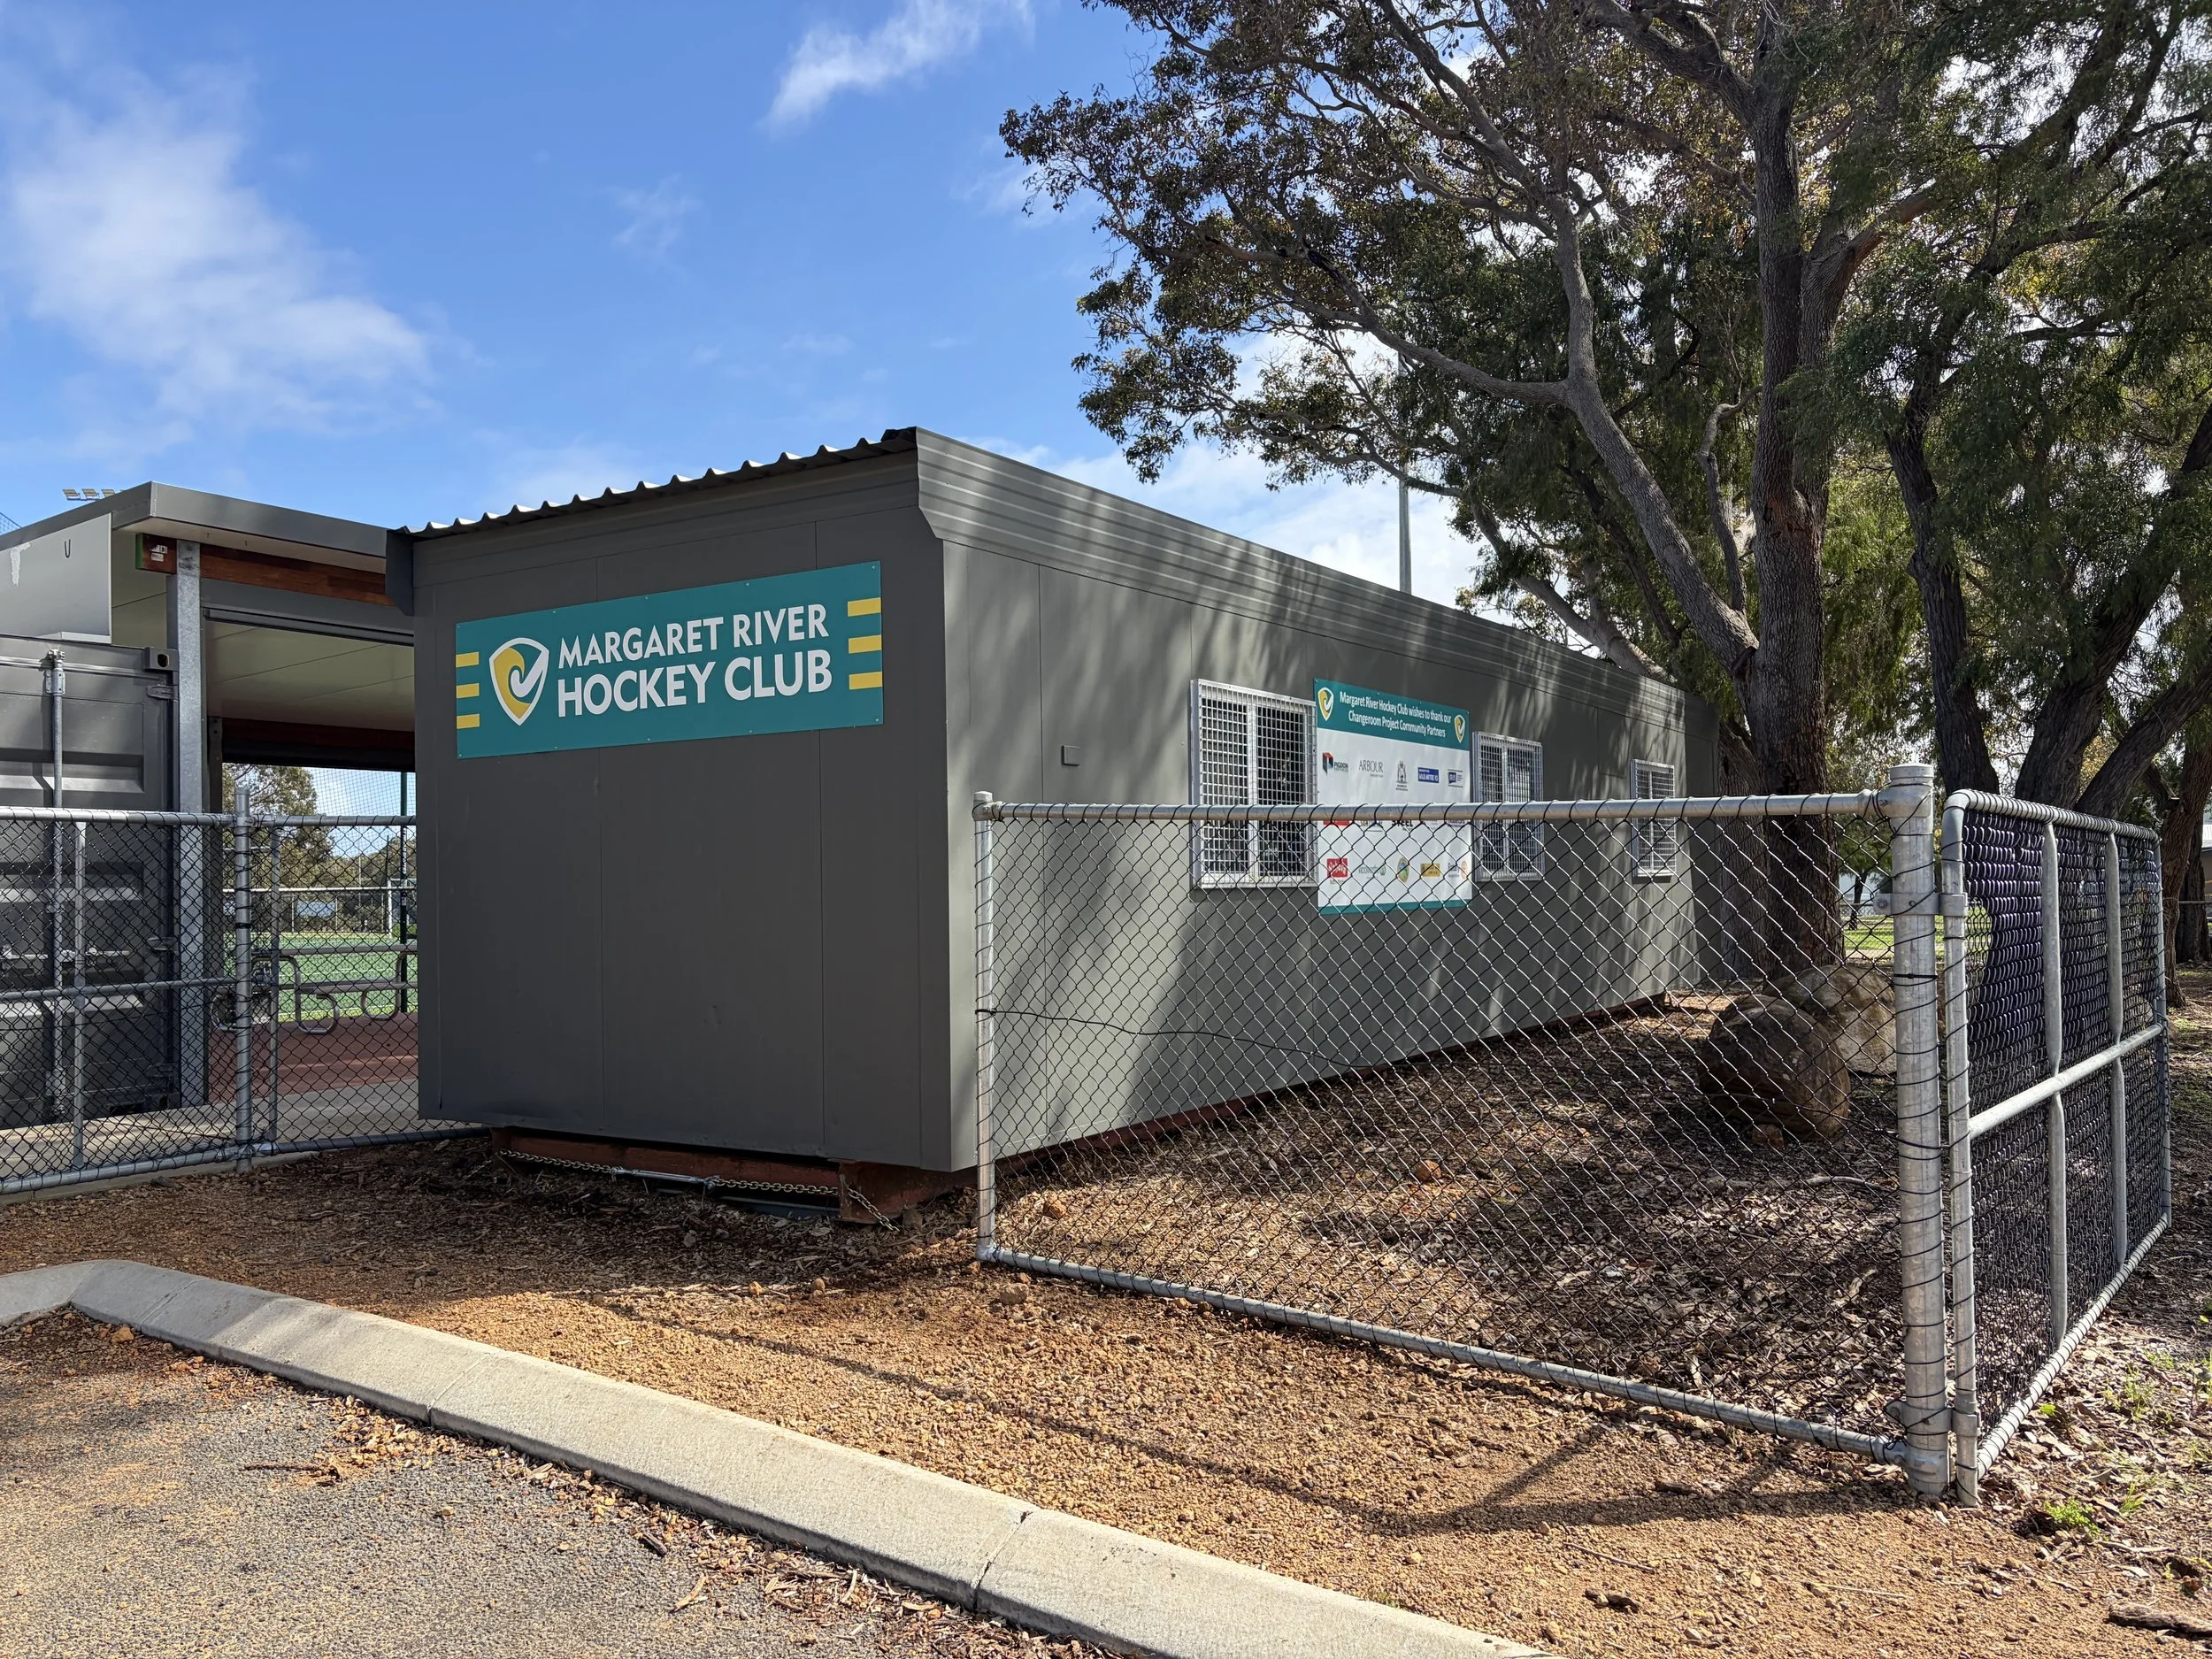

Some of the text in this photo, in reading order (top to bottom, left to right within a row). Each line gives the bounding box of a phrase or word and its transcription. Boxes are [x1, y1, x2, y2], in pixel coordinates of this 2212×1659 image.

[558, 603, 830, 670] MARGARET RIVER
[557, 649, 833, 718] HOCKEY CLUB
[1340, 691, 1365, 707] Margaret
[1365, 696, 1379, 710] River
[1379, 699, 1397, 715] Hockey
[1397, 703, 1408, 715] Club
[1408, 707, 1425, 719] wishes
[1425, 710, 1430, 719] to
[1430, 711, 1443, 722] thank
[1348, 710, 1446, 738] Changeroom Project Community Partners
[1359, 759, 1383, 772] ARBOUR
